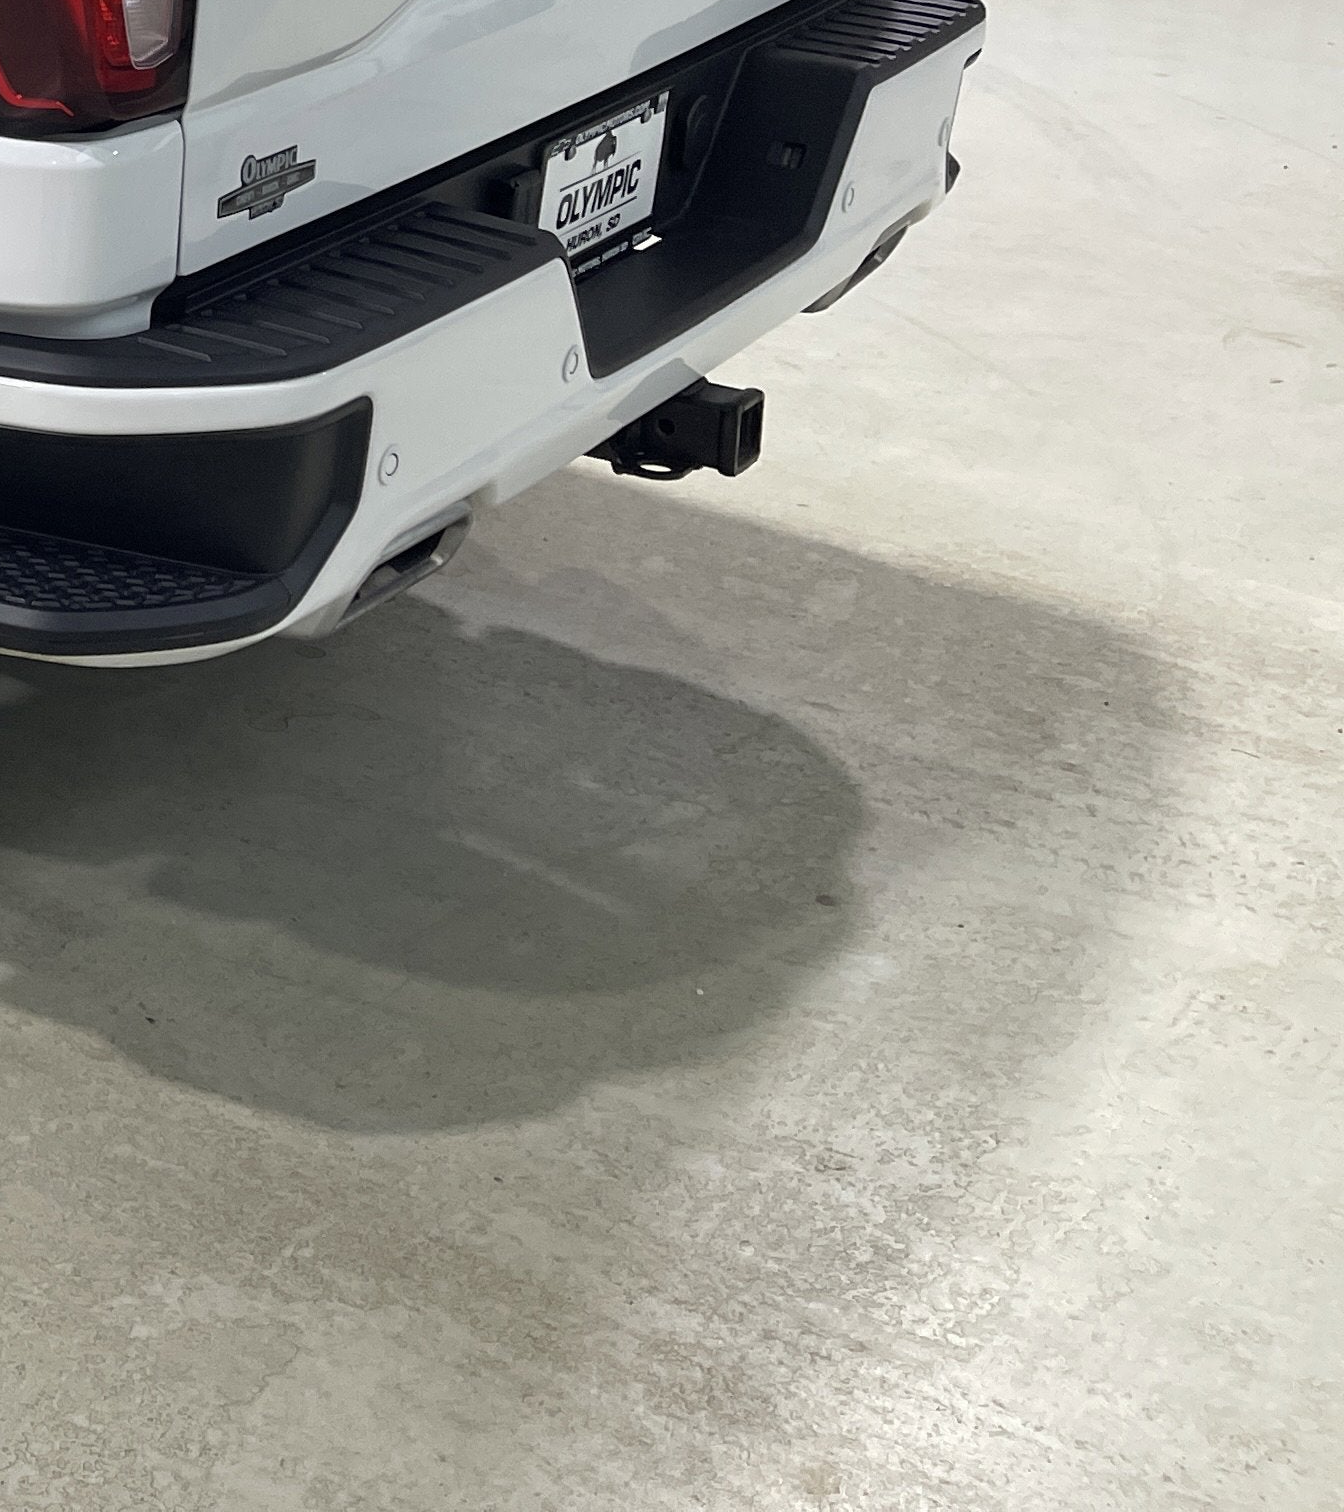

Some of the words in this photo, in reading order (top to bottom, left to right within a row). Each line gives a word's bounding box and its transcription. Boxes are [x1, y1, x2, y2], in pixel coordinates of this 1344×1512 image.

[242, 147, 298, 185] OLYMPIC
[556, 159, 642, 230] OLYMPIC
[606, 213, 621, 232] SD
